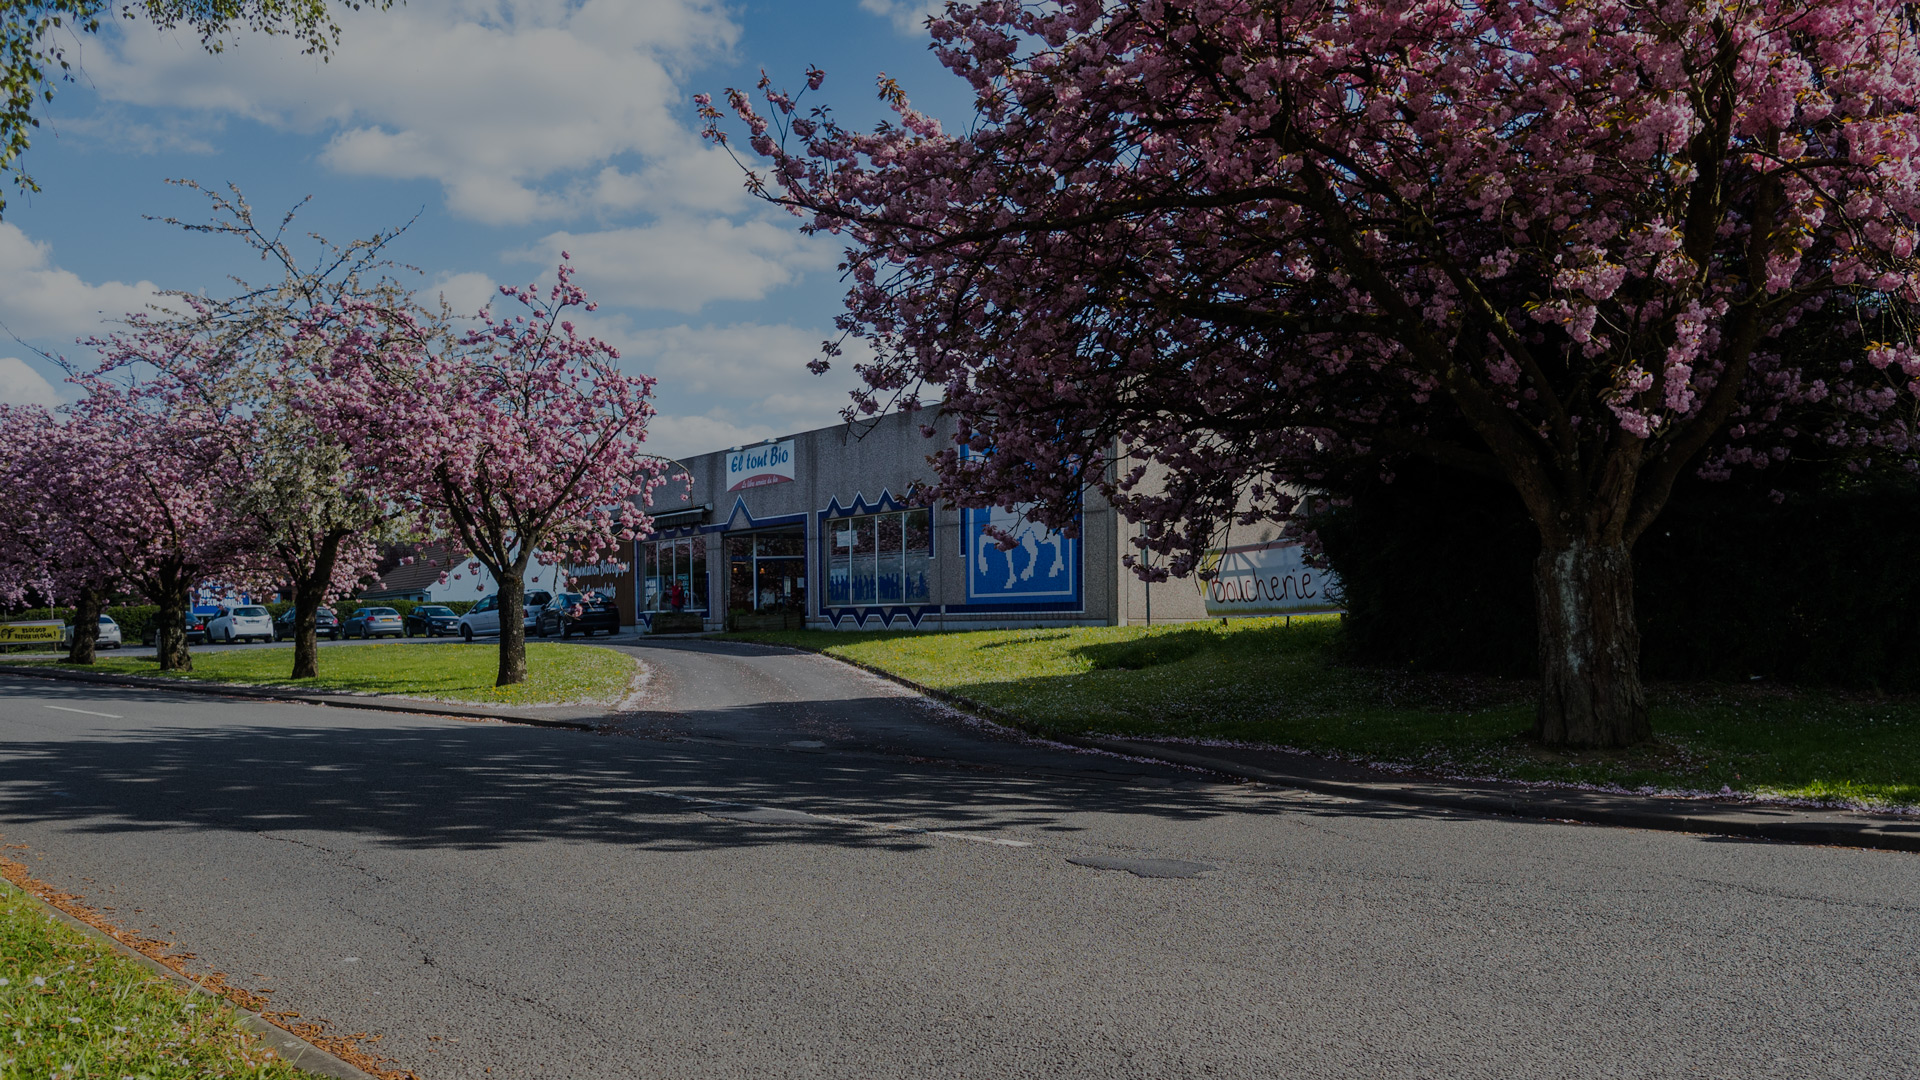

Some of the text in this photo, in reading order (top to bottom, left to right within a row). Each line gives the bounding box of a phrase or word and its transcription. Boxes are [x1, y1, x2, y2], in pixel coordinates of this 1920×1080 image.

[731, 446, 788, 473] El tout Bio
[1211, 568, 1316, 603] Boucherie
